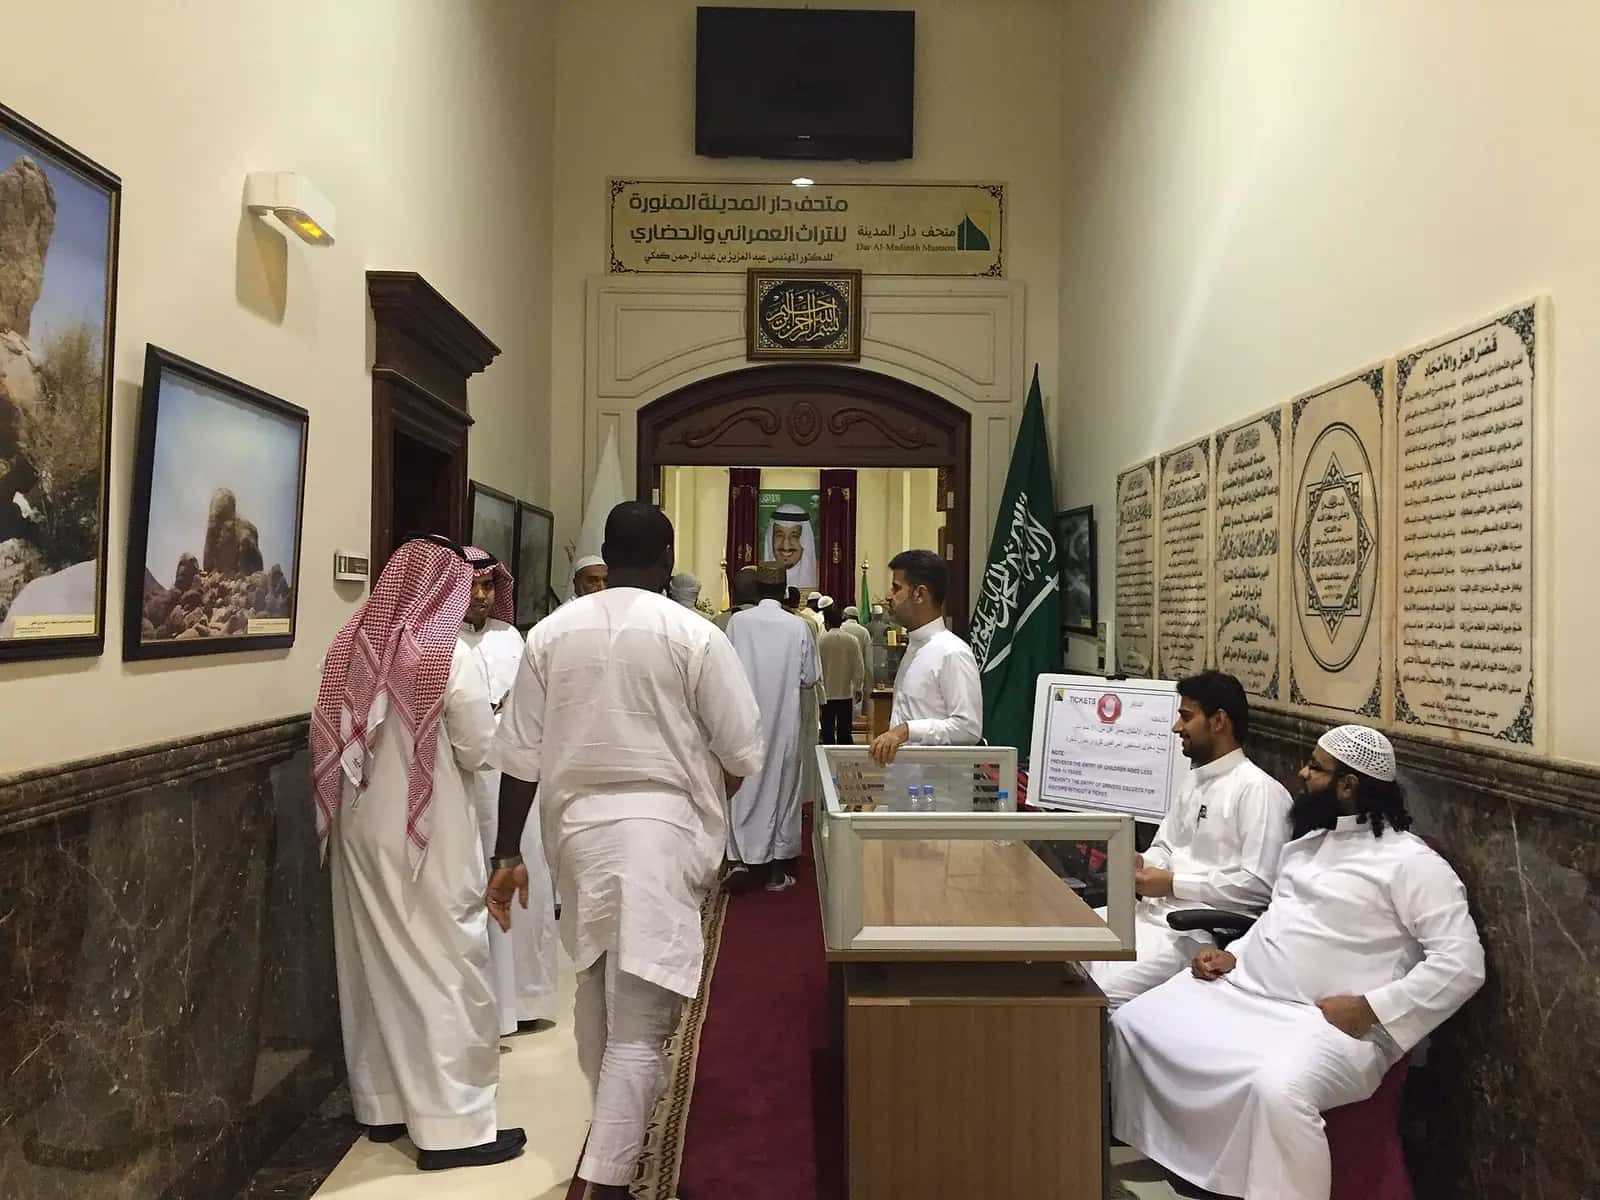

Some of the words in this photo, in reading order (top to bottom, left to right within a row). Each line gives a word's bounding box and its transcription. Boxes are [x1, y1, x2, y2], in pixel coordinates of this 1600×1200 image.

[629, 193, 696, 214] المنورة
[698, 193, 766, 214] المدينة
[768, 195, 792, 214] دار
[795, 195, 848, 212] متحف
[630, 224, 715, 244] والحضاري
[717, 224, 794, 245] العمراني
[795, 224, 847, 245] للتراث
[857, 223, 896, 239] المدينة
[898, 224, 917, 240] دار
[921, 224, 956, 238] متحف
[1069, 695, 1096, 705] TICKETS
